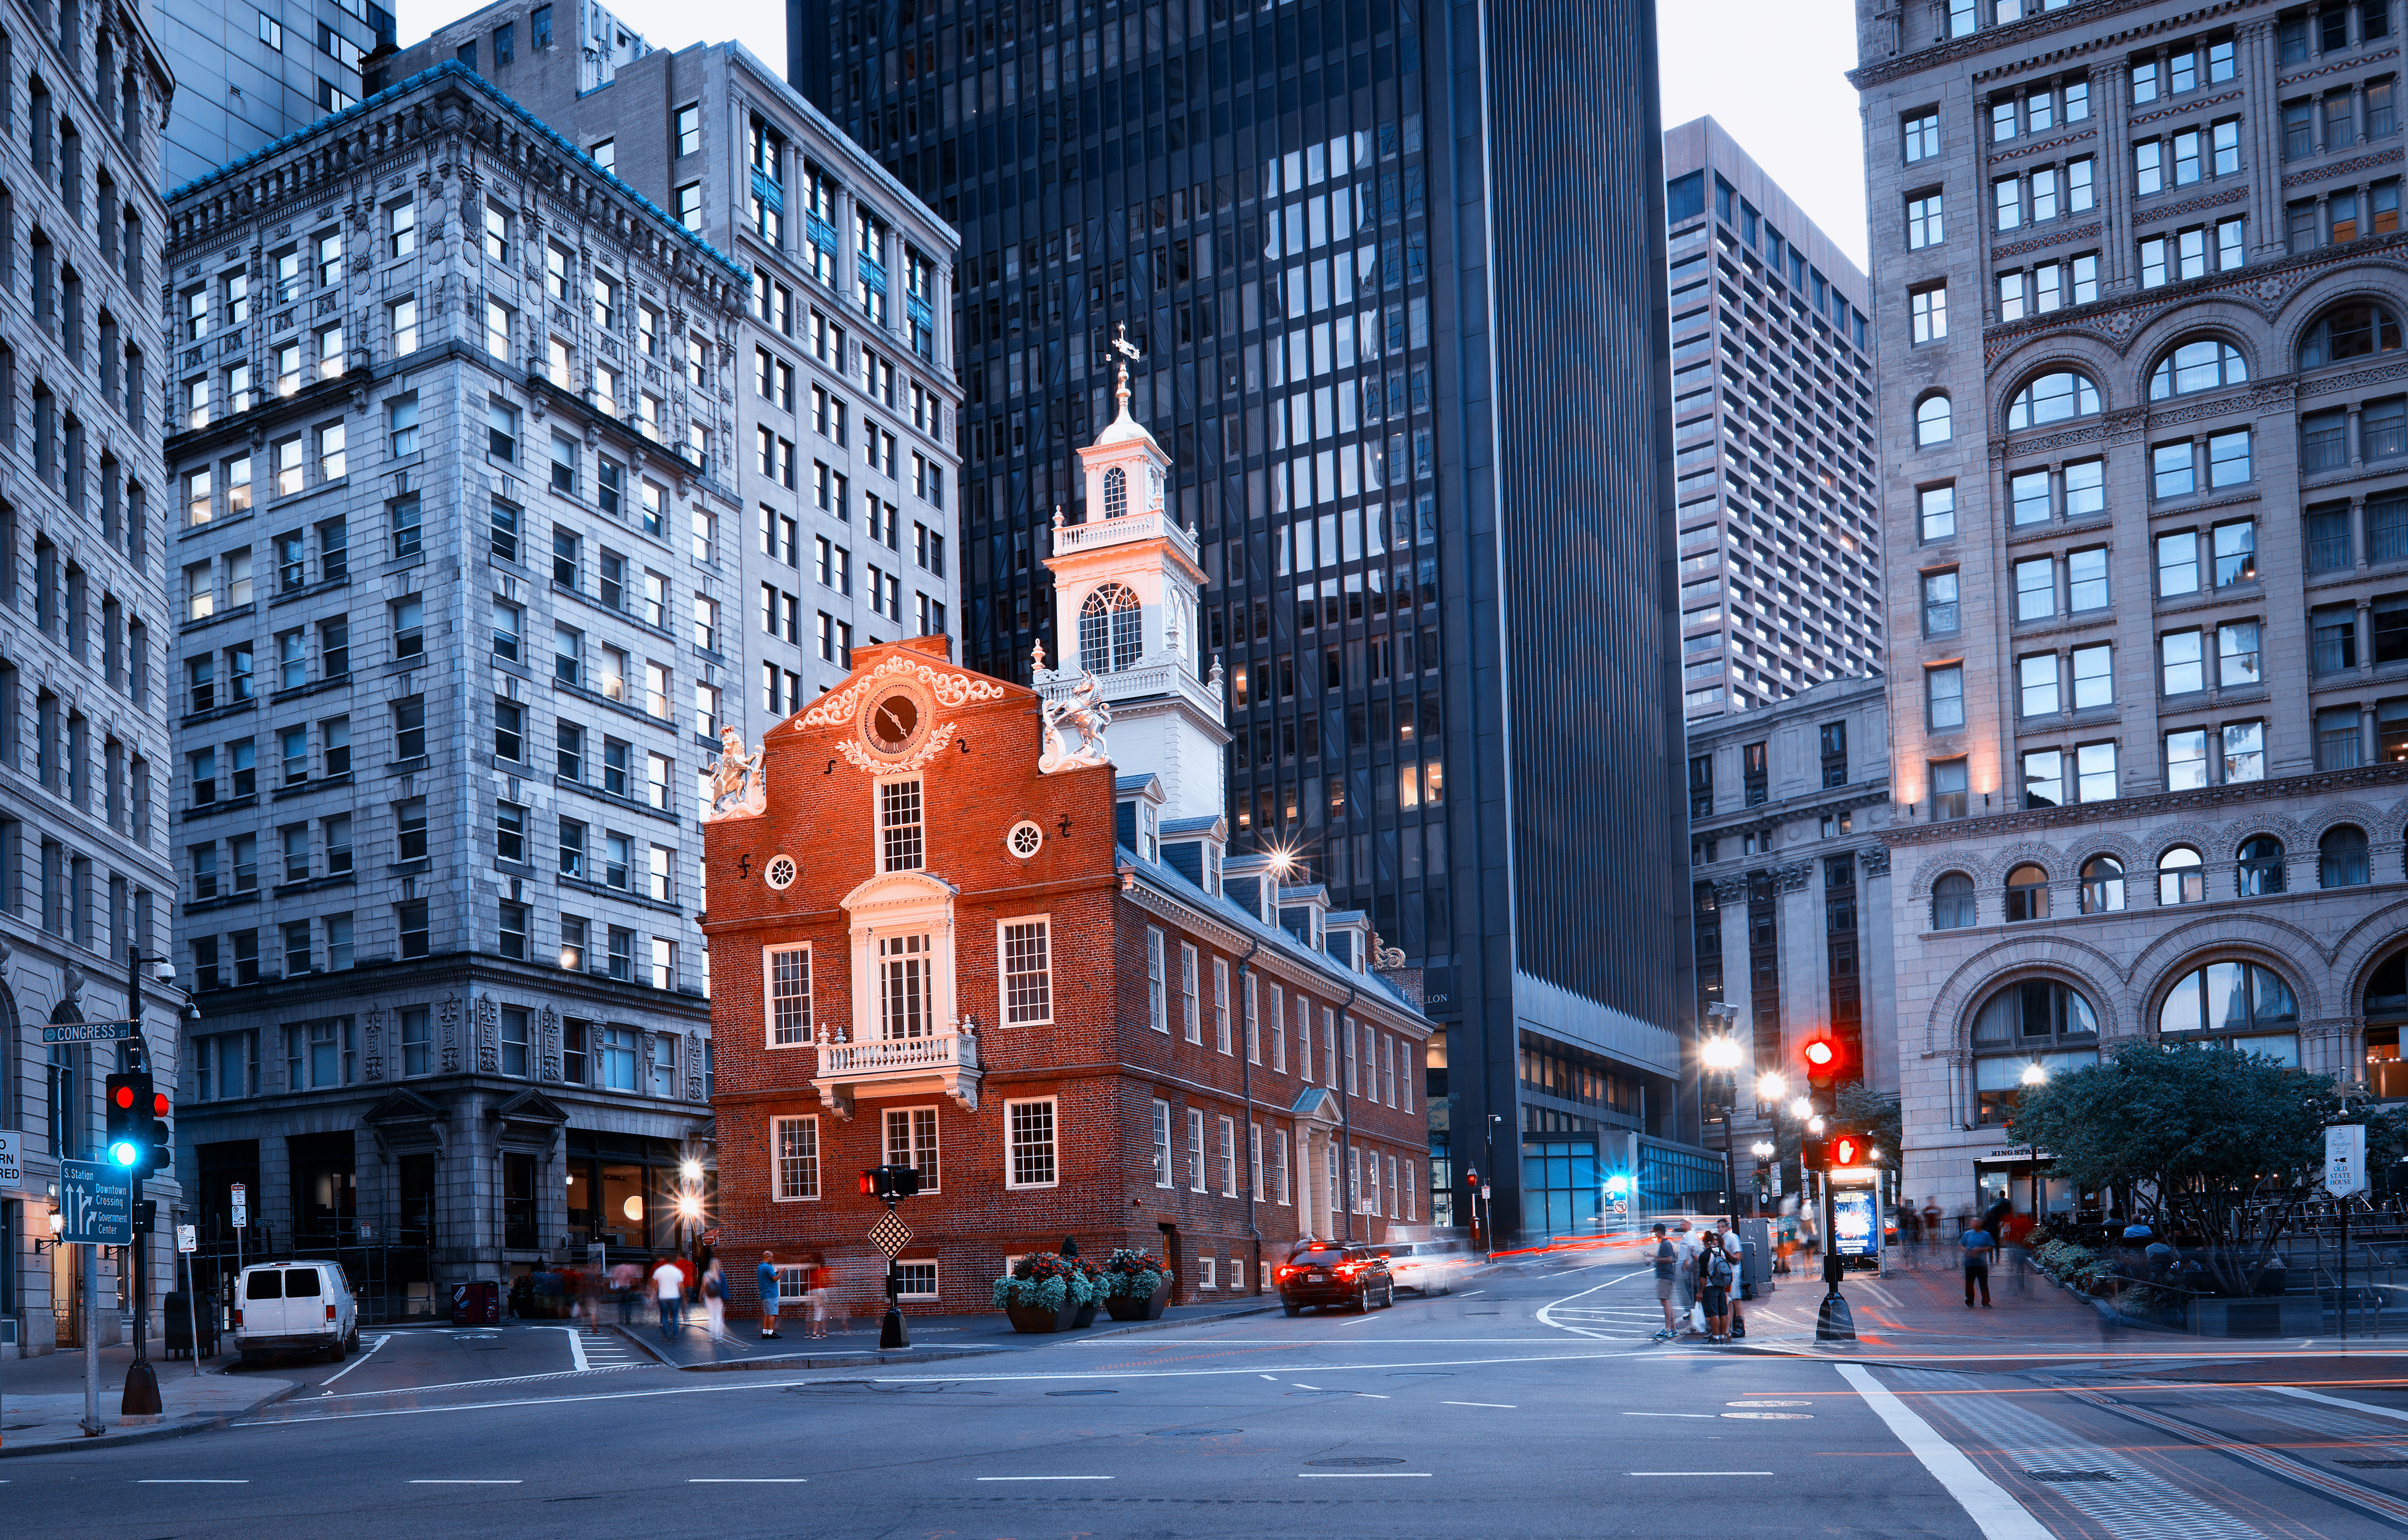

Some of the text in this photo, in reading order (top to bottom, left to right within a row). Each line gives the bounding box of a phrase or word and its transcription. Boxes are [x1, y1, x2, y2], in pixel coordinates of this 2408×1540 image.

[58, 1024, 115, 1040] CONGRESS
[0, 1139, 6, 1150] O
[0, 1154, 14, 1165] RN
[64, 1168, 94, 1181] S. Station
[96, 1183, 126, 1195] Downtown
[96, 1196, 123, 1209] Crossing
[98, 1212, 127, 1223] Government
[98, 1224, 117, 1234] Center
